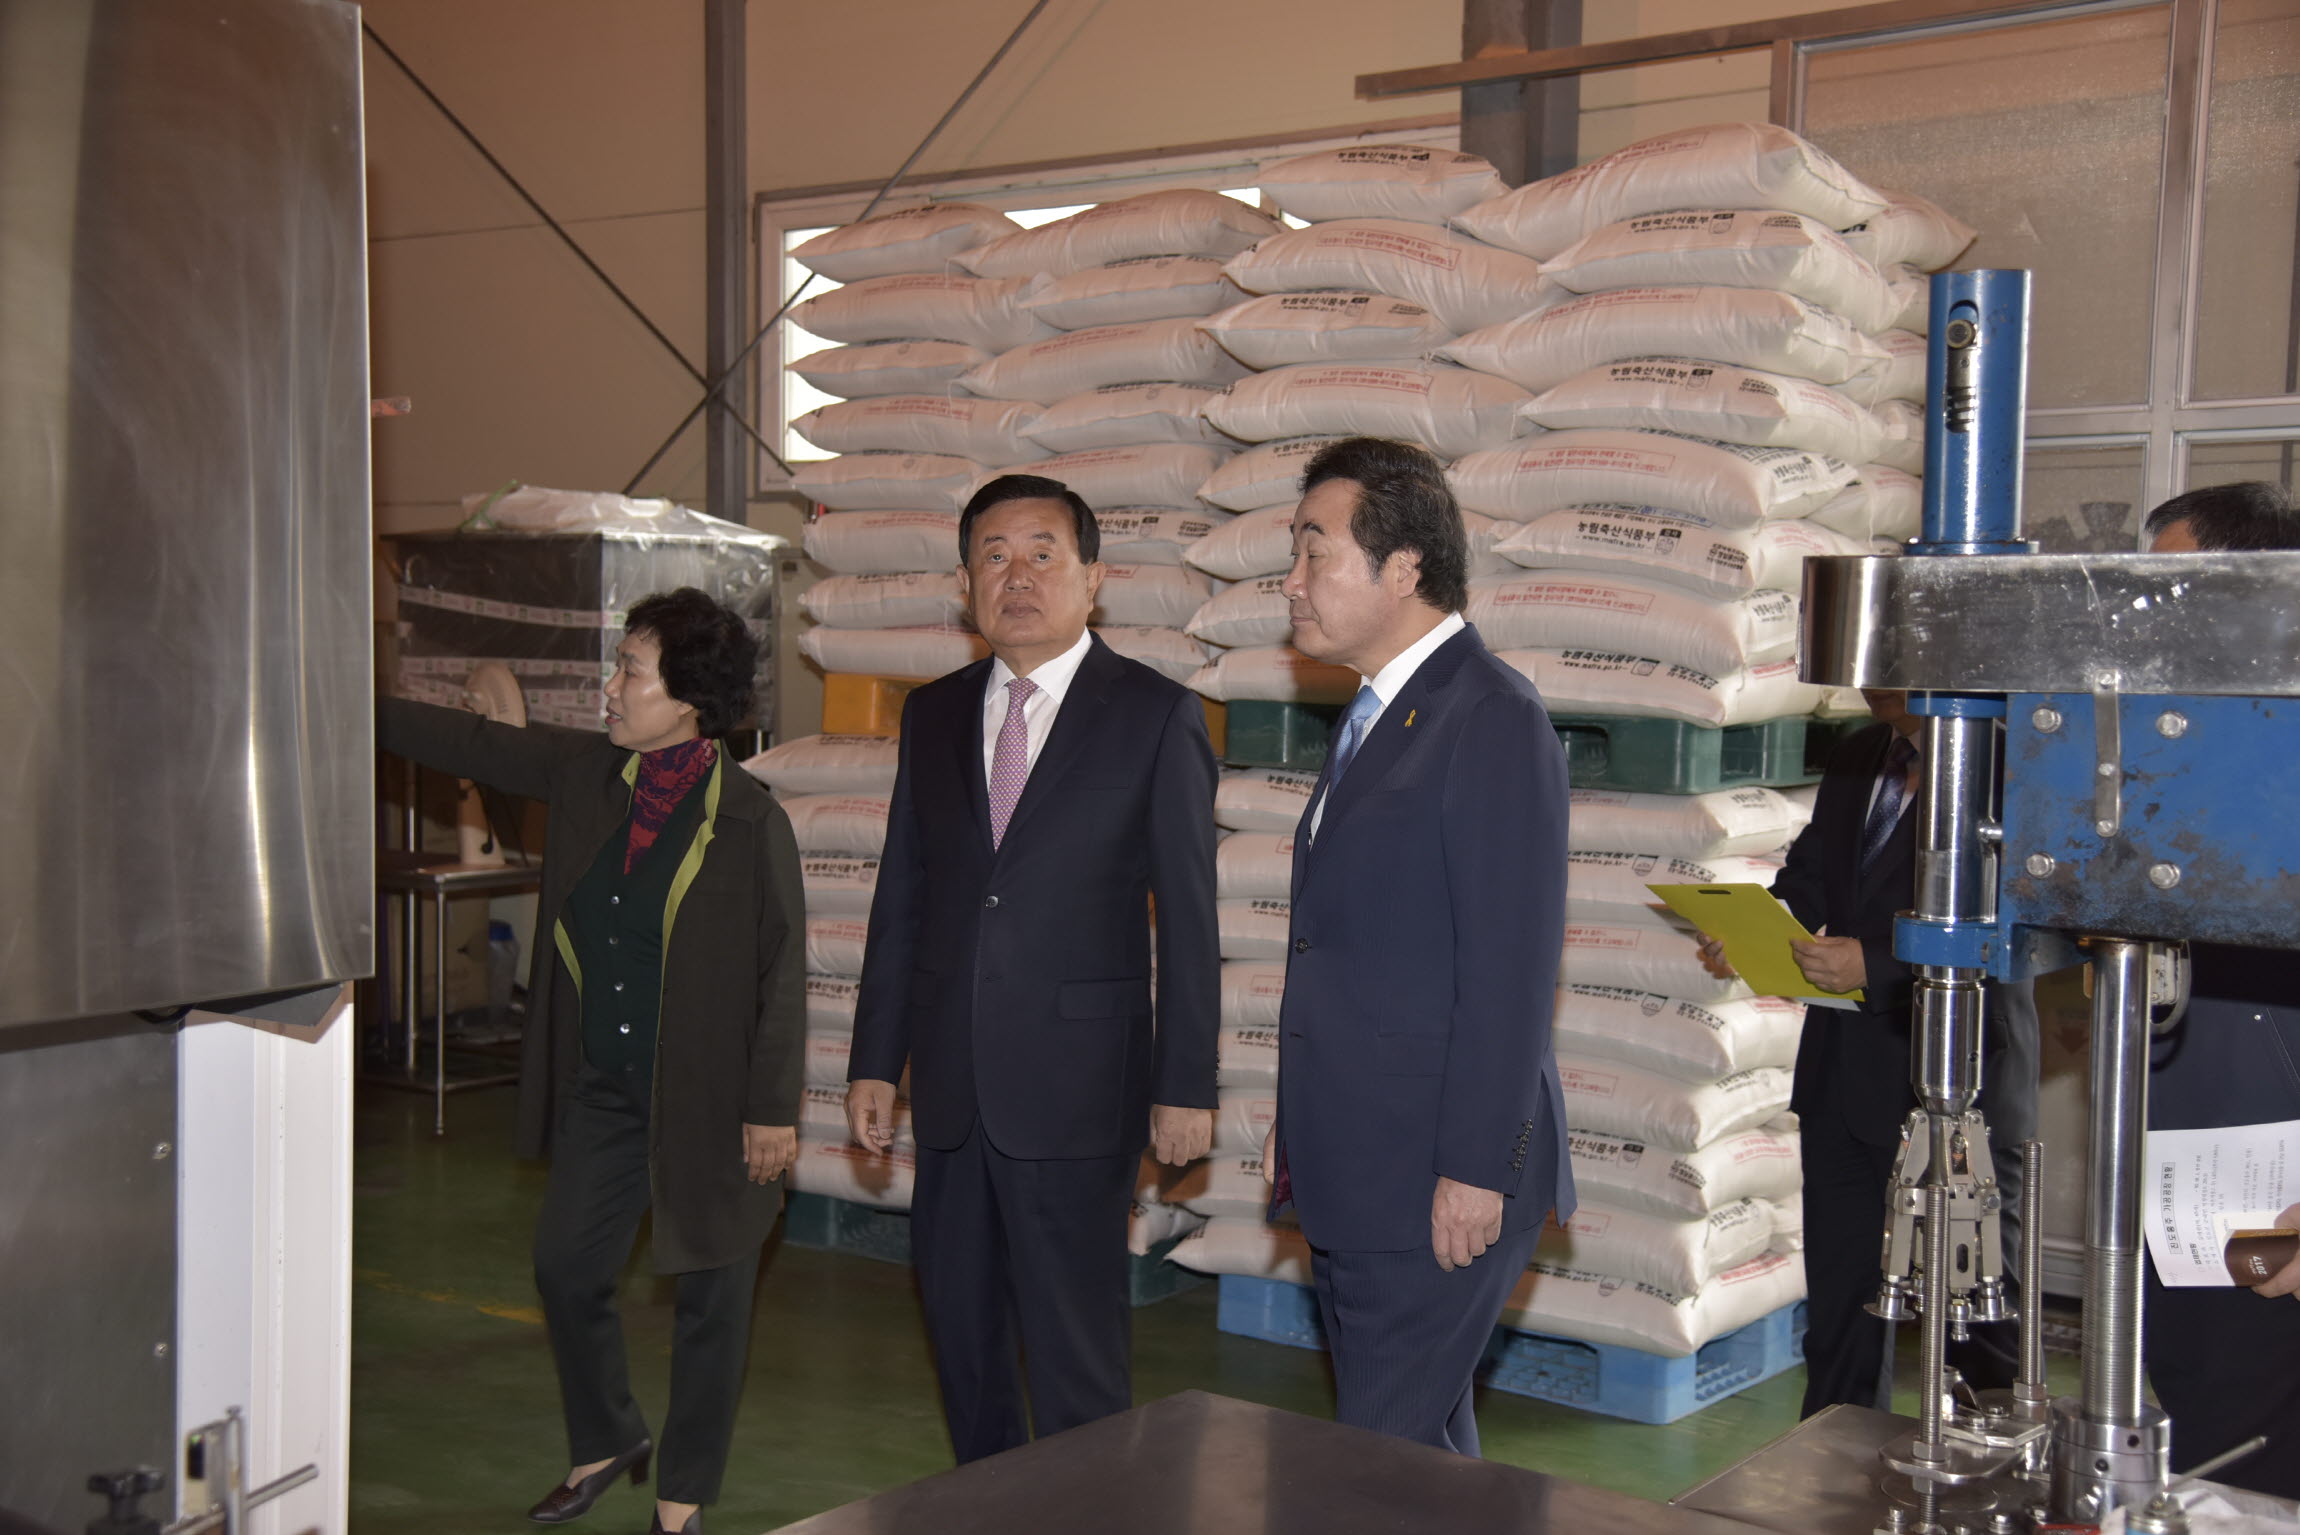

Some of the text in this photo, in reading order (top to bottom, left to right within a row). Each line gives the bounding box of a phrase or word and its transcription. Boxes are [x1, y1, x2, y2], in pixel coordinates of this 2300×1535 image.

[1610, 366, 1689, 379] 농림축산식품부
[1577, 521, 1657, 542] 농림축산식품부
[1562, 650, 1637, 664] 농림축산식품부
[2252, 1255, 2268, 1276] 2017
